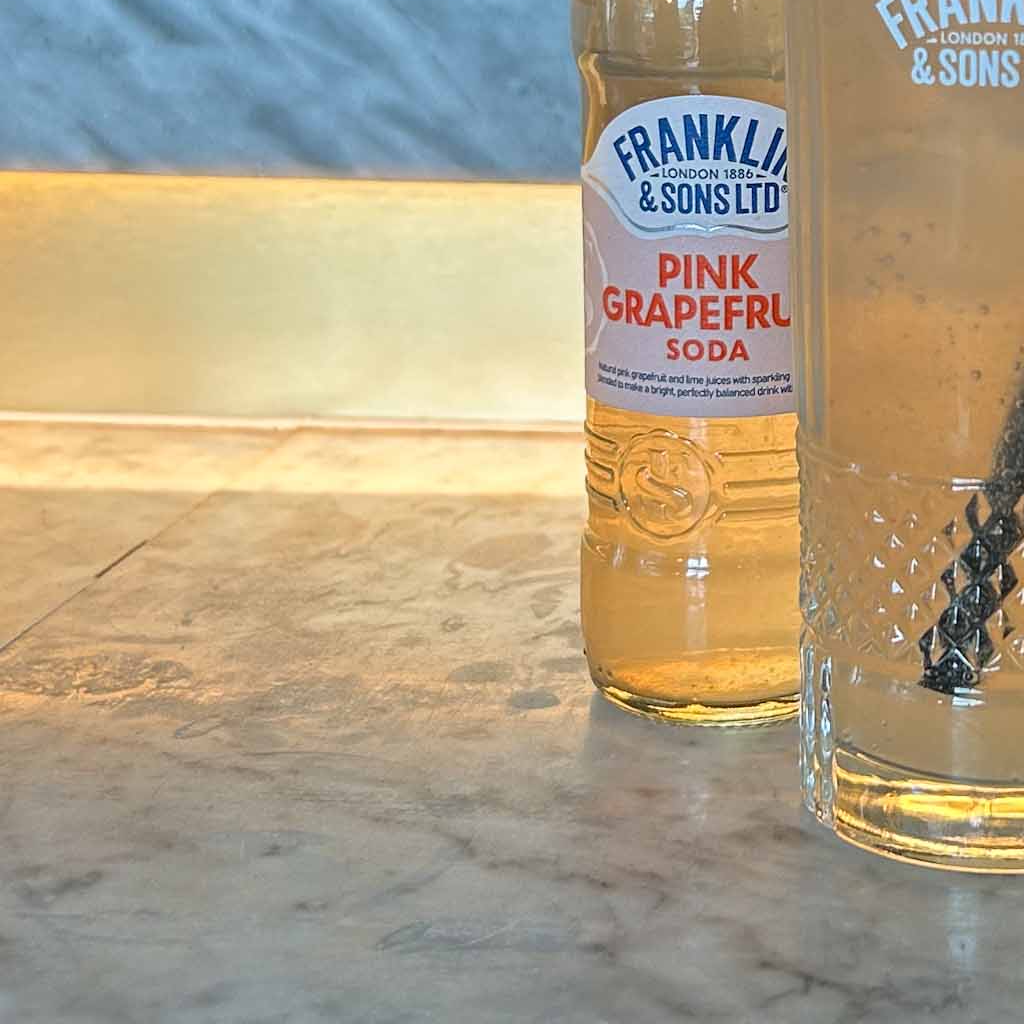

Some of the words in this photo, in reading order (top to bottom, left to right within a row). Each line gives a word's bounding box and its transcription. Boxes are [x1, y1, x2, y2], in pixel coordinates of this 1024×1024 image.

[940, 31, 1008, 45] LONDON
[911, 47, 936, 86] &
[938, 49, 1021, 88] SONS
[662, 168, 719, 180] LONDON
[724, 168, 754, 180] 1886
[640, 181, 659, 213] &
[661, 182, 731, 215] SONS
[659, 252, 759, 290] PINK
[666, 338, 750, 363] SODA
[669, 375, 684, 384] and
[686, 374, 704, 385] lime
[706, 375, 731, 387] juices
[733, 374, 751, 385] with
[752, 371, 791, 385] sparkling
[716, 386, 756, 398] balanced
[757, 384, 779, 396] drink
